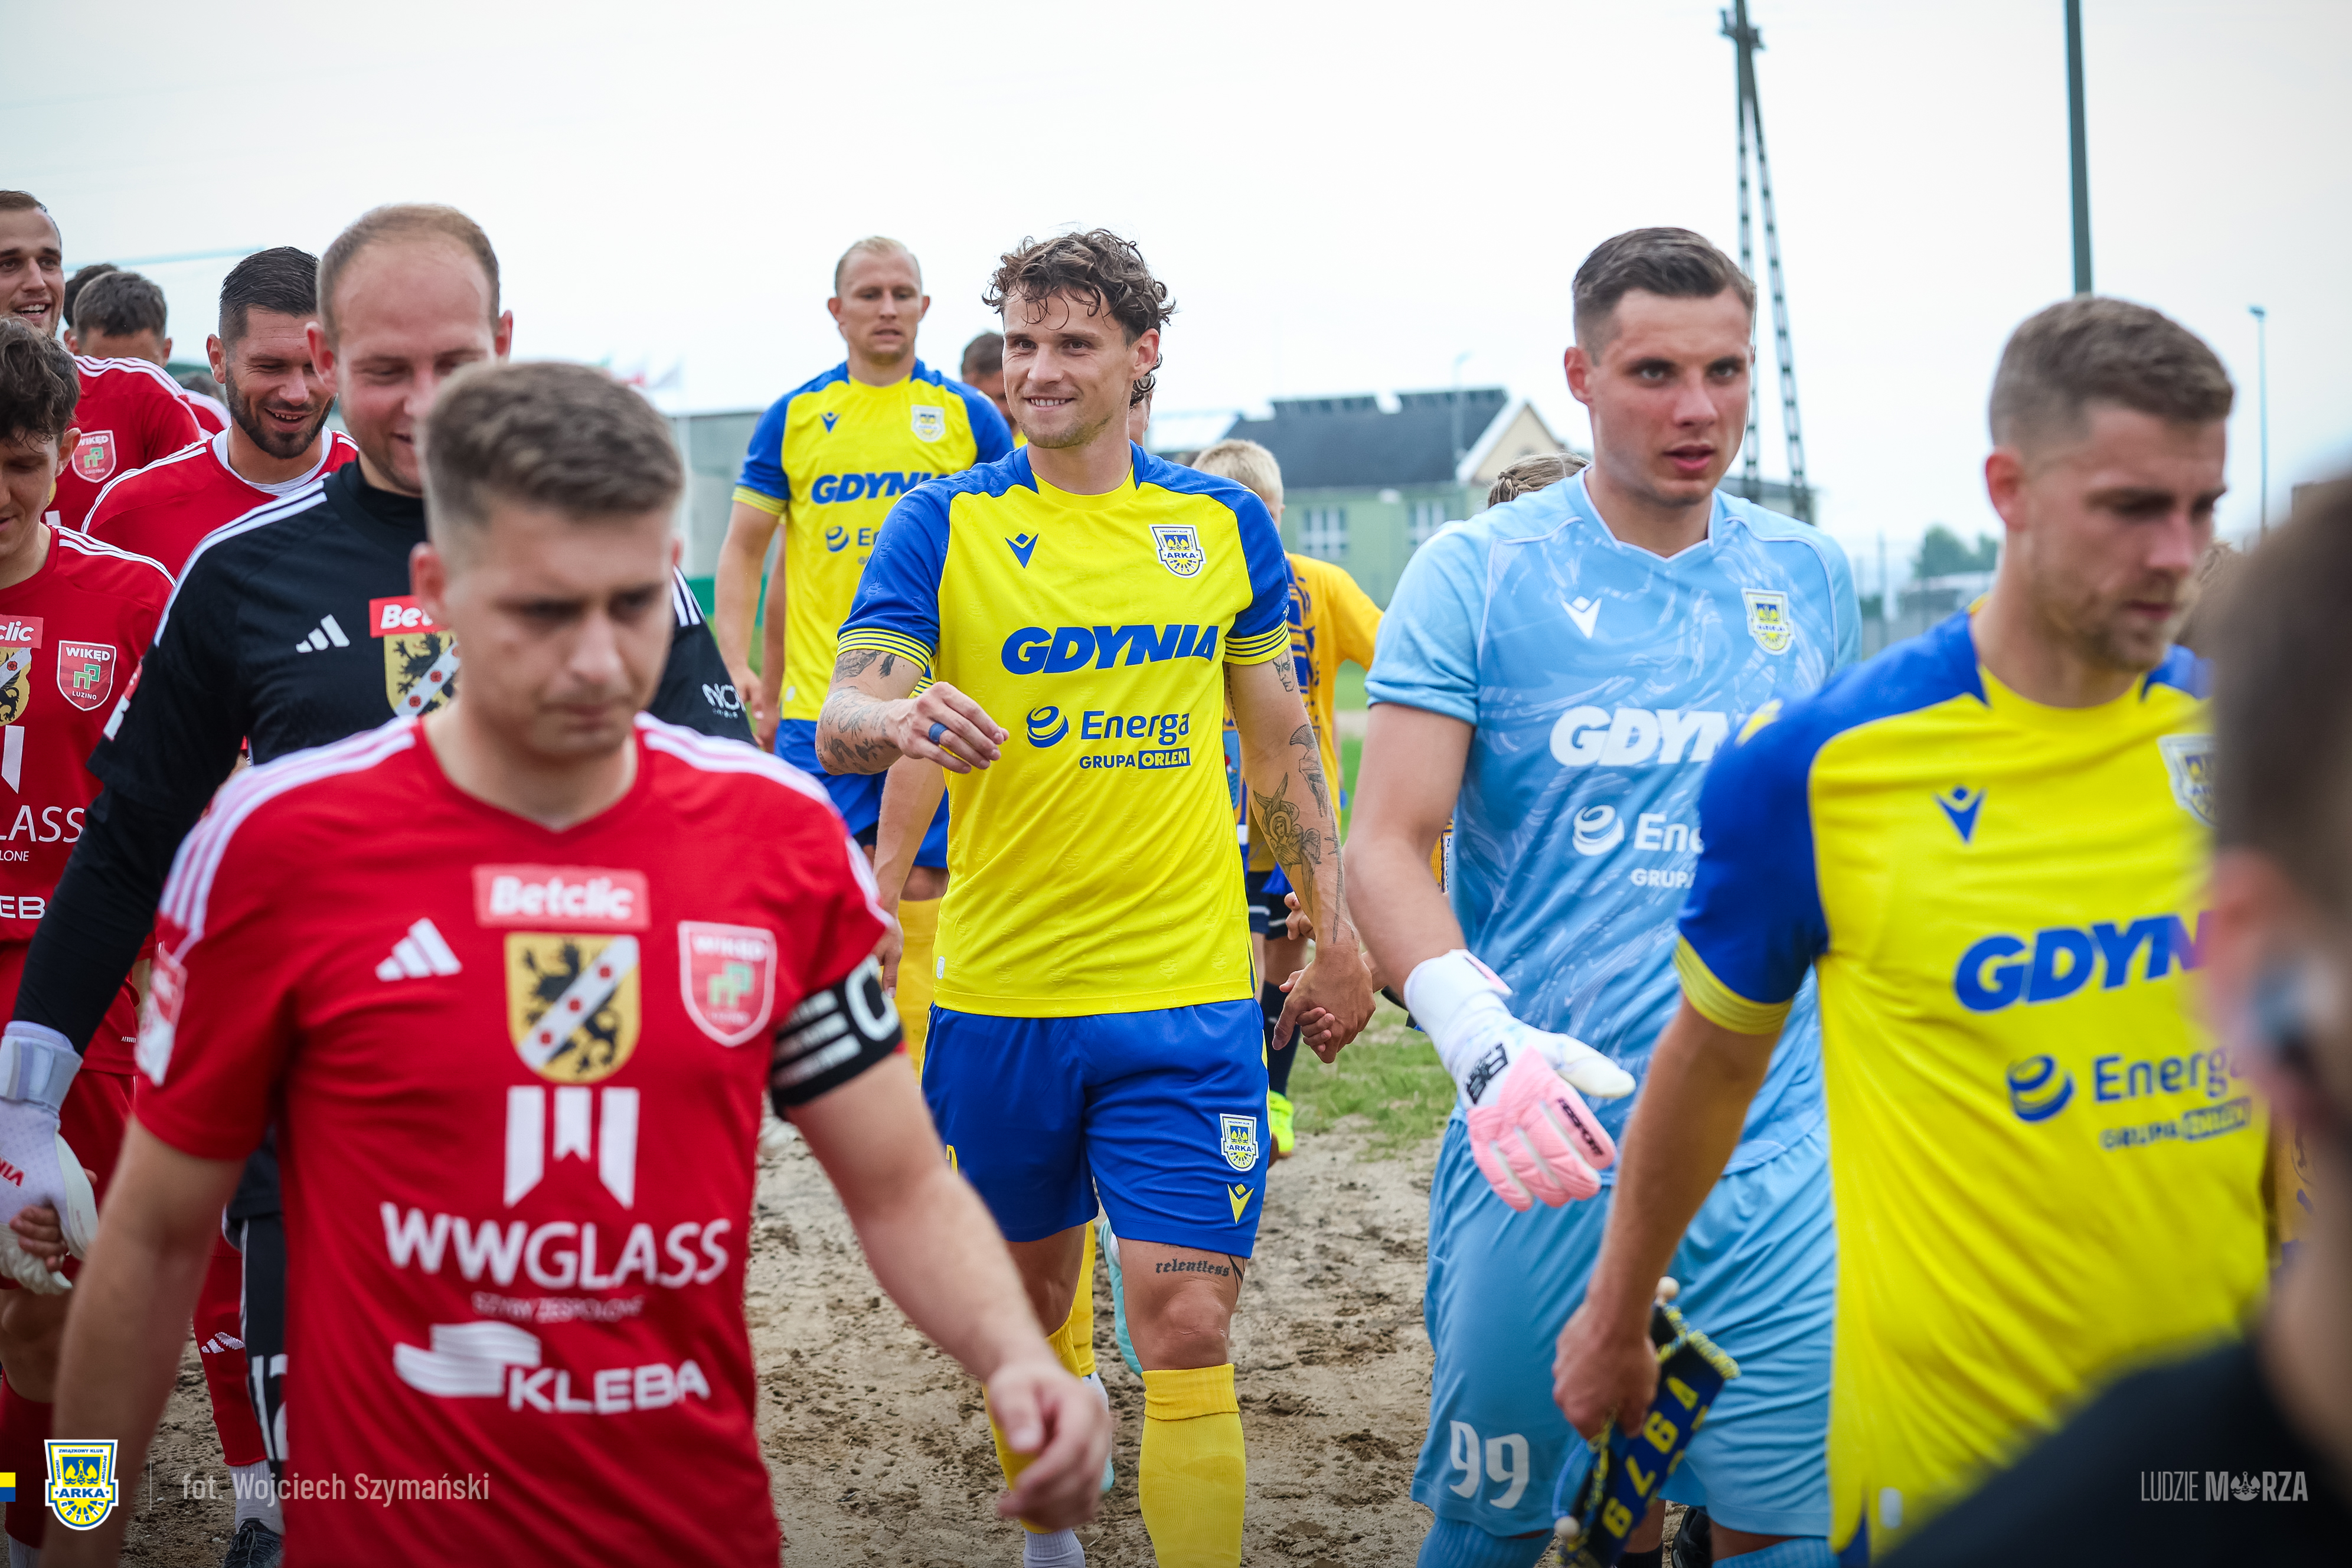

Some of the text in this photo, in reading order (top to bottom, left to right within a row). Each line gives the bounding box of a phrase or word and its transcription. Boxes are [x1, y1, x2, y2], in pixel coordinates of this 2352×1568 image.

[811, 472, 950, 504] GDYN
[66, 646, 111, 662] WIKĘD
[1001, 625, 1219, 675] GDYNIA
[72, 691, 97, 700] LUZINO
[1080, 710, 1190, 746] Energa
[1079, 750, 1187, 769] GRUPA ORLEN
[489, 876, 633, 920] Betclic
[380, 1202, 731, 1289] WWGLASS
[1155, 1258, 1230, 1277] relentless
[509, 1360, 711, 1415] KLEBA
[1449, 1420, 1530, 1510] 99
